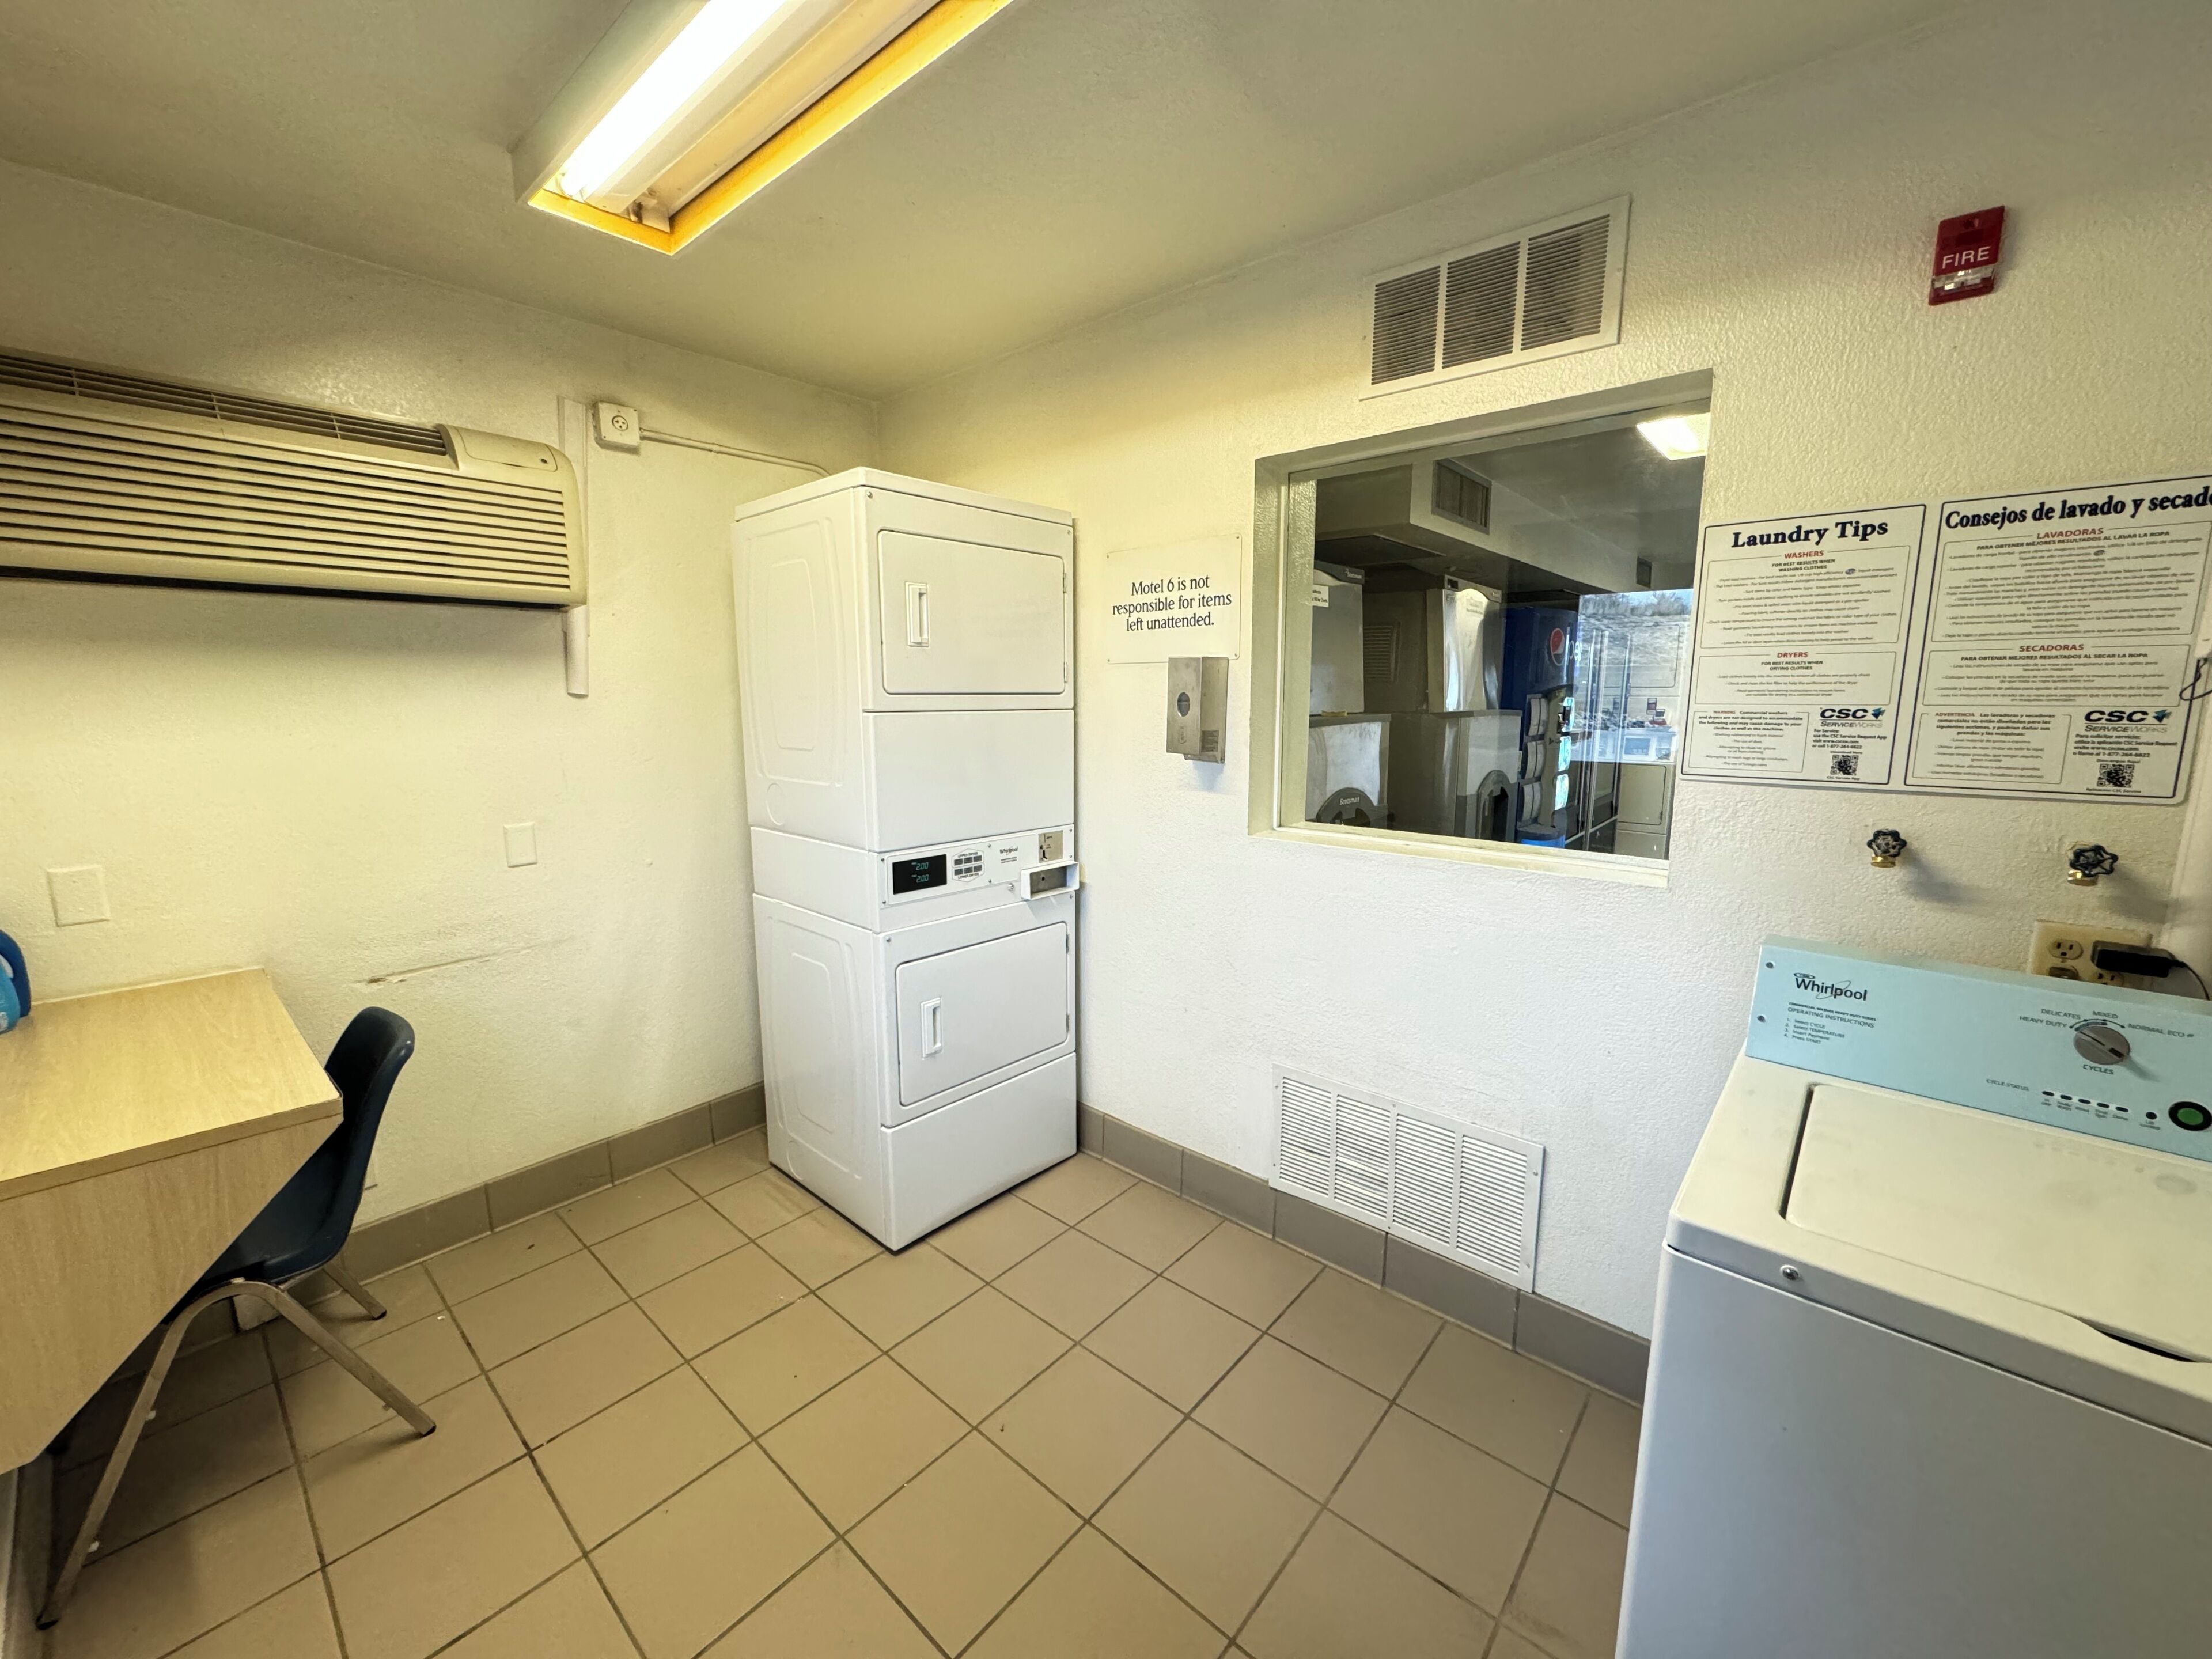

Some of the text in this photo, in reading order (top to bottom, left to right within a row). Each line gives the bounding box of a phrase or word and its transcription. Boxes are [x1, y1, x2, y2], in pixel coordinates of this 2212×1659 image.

[1942, 246, 1991, 269] FIRE
[1945, 506, 2027, 530] Consejos
[2032, 502, 2055, 522] de
[2058, 495, 2126, 520] lavado
[2132, 498, 2145, 518] y
[1731, 520, 1889, 548] Laundry Tips
[2036, 527, 2104, 540] LAVADORAS
[1783, 550, 1824, 559] WASHERS
[1131, 575, 1210, 596] Motel 6 is not
[1113, 593, 1232, 617] responsible for items
[1127, 612, 1214, 631] left unattended.
[2018, 643, 2085, 652] SECADORAS
[1819, 707, 1869, 719] CSC
[2083, 710, 2149, 723] CSC
[2084, 724, 2168, 733] SERVICEWORKS
[999, 846, 1018, 854] Whirlpool
[1795, 978, 1868, 1001] Whirlpool
[1787, 1006, 1874, 1028] OPERATING INSTRUCTIONS
[2041, 1008, 2081, 1020] DELICATES
[2019, 1015, 2067, 1028] HEAVY DUTY
[2128, 1023, 2185, 1037] NORMAL ECO
[2083, 1064, 2114, 1075] CYCLES
